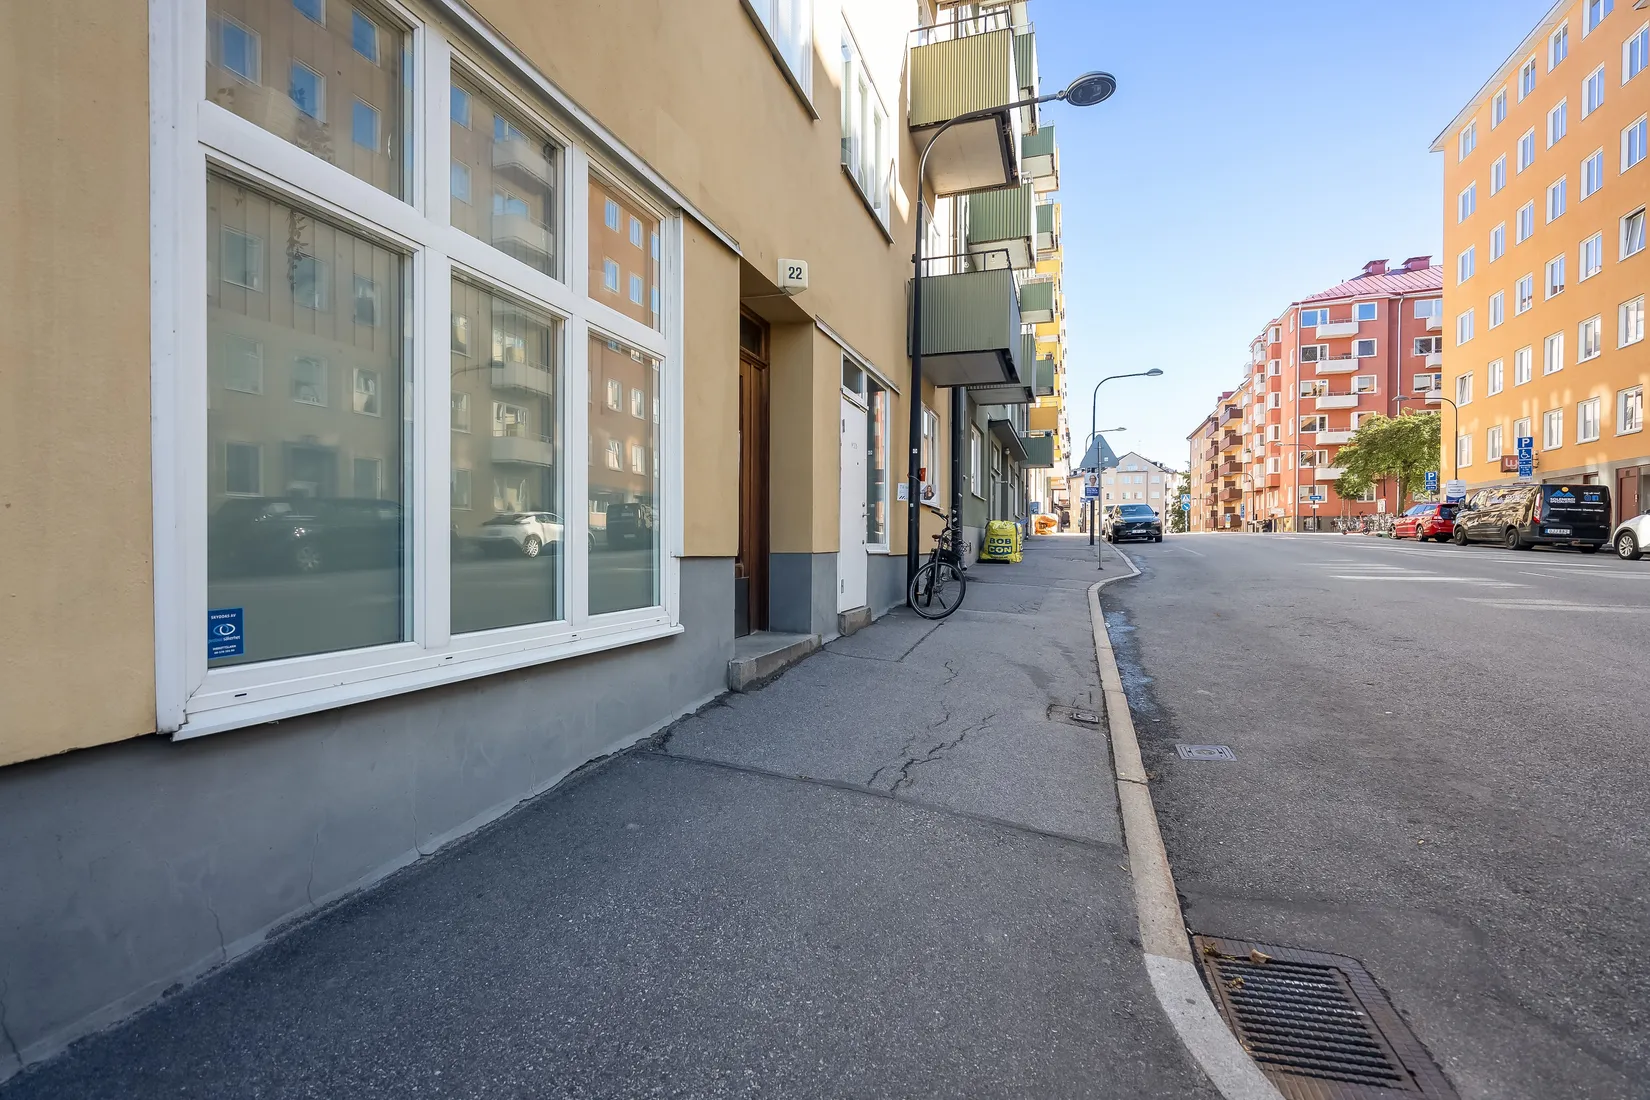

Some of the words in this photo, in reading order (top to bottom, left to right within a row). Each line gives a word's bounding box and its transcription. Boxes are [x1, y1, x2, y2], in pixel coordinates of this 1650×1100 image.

[788, 266, 803, 280] 22
[1521, 438, 1530, 448] P
[1428, 472, 1435, 480] P
